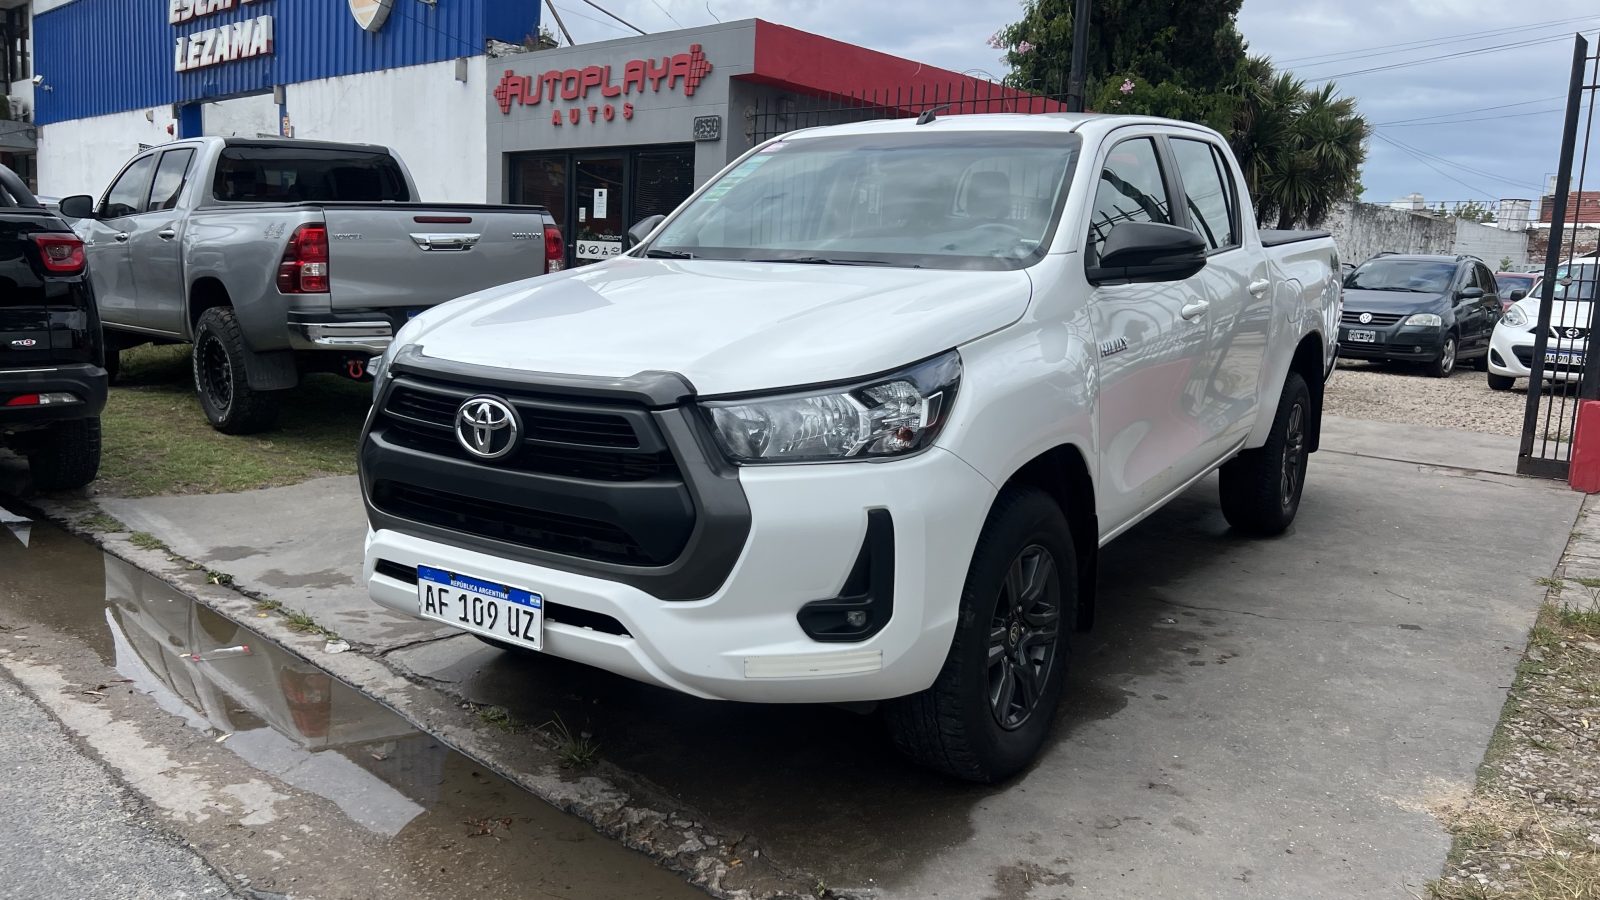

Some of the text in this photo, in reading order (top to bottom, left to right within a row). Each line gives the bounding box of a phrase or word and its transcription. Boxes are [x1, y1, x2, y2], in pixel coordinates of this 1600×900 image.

[175, 15, 273, 72] LEZAMA
[505, 51, 696, 107] AUTOPLAYA
[552, 102, 634, 126] AUTOS
[425, 584, 535, 642] AF 109 UZ
[450, 579, 509, 600] REPÚBLICA ARGENTINA
